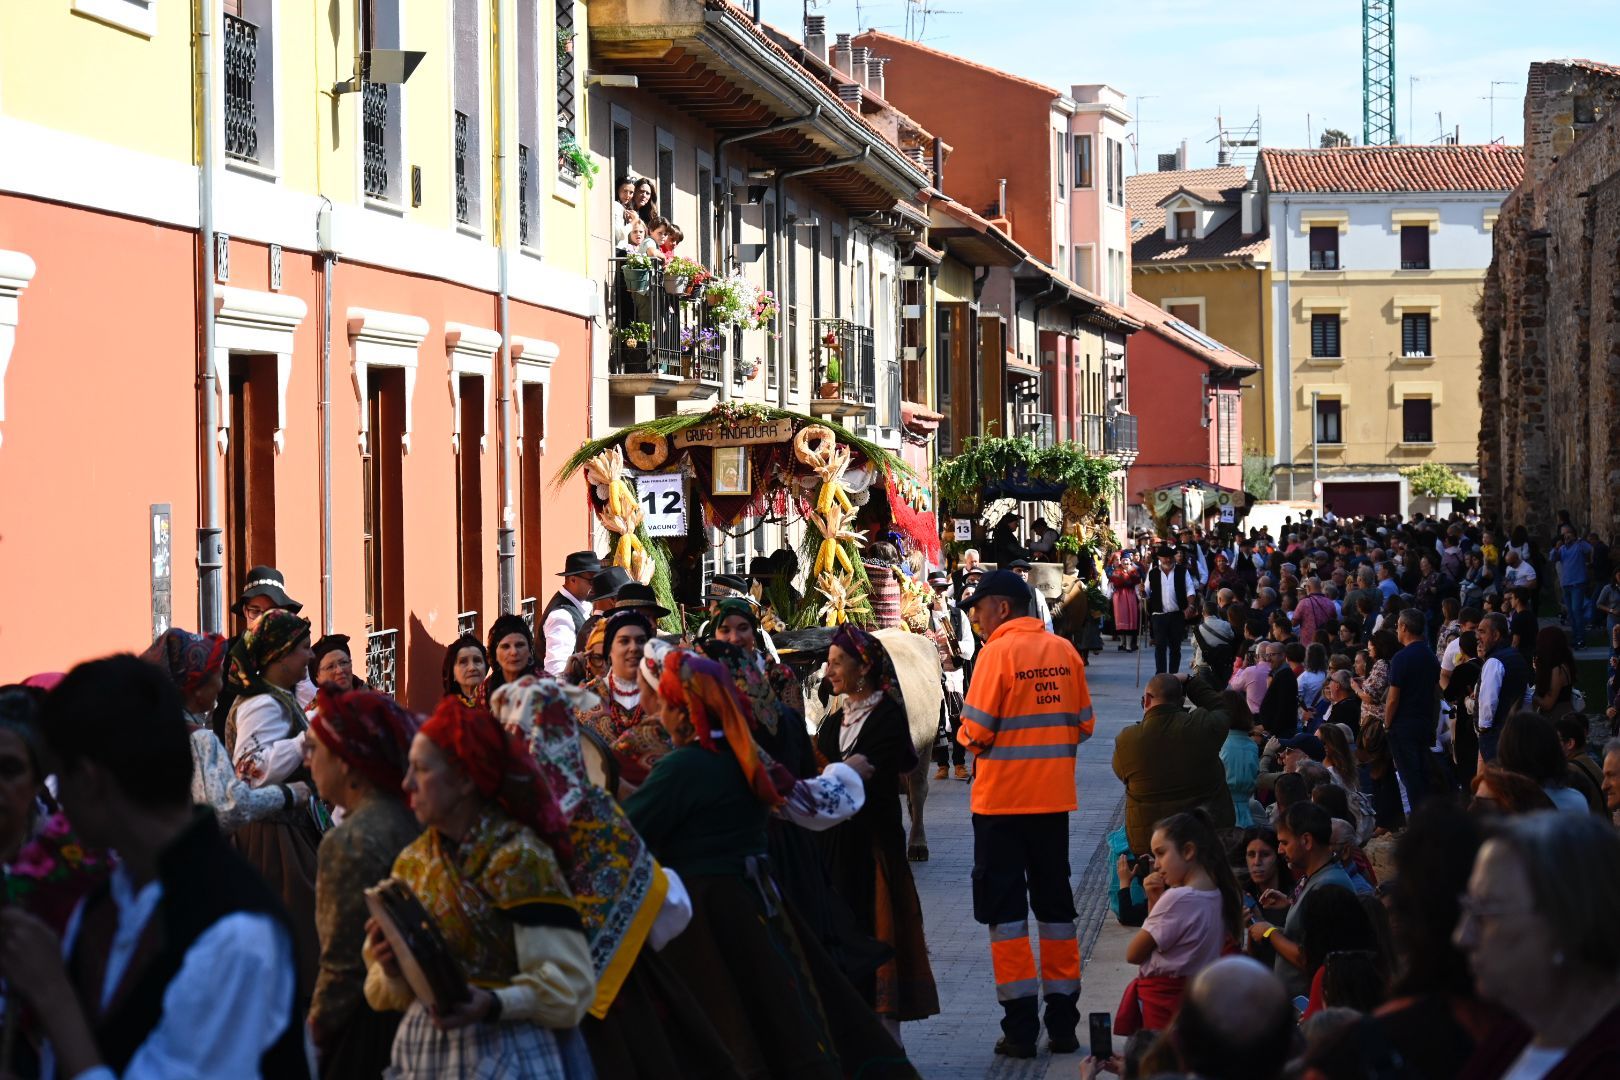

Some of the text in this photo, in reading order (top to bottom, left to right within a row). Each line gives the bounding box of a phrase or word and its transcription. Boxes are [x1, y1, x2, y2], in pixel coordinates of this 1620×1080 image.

[686, 428, 713, 442] GRUPO
[642, 491, 682, 514] 12
[956, 525, 970, 533] 13
[1015, 664, 1071, 680] PROTECCIÓN
[1034, 681, 1059, 692] CIVIL
[1036, 692, 1061, 704] LEÓN
